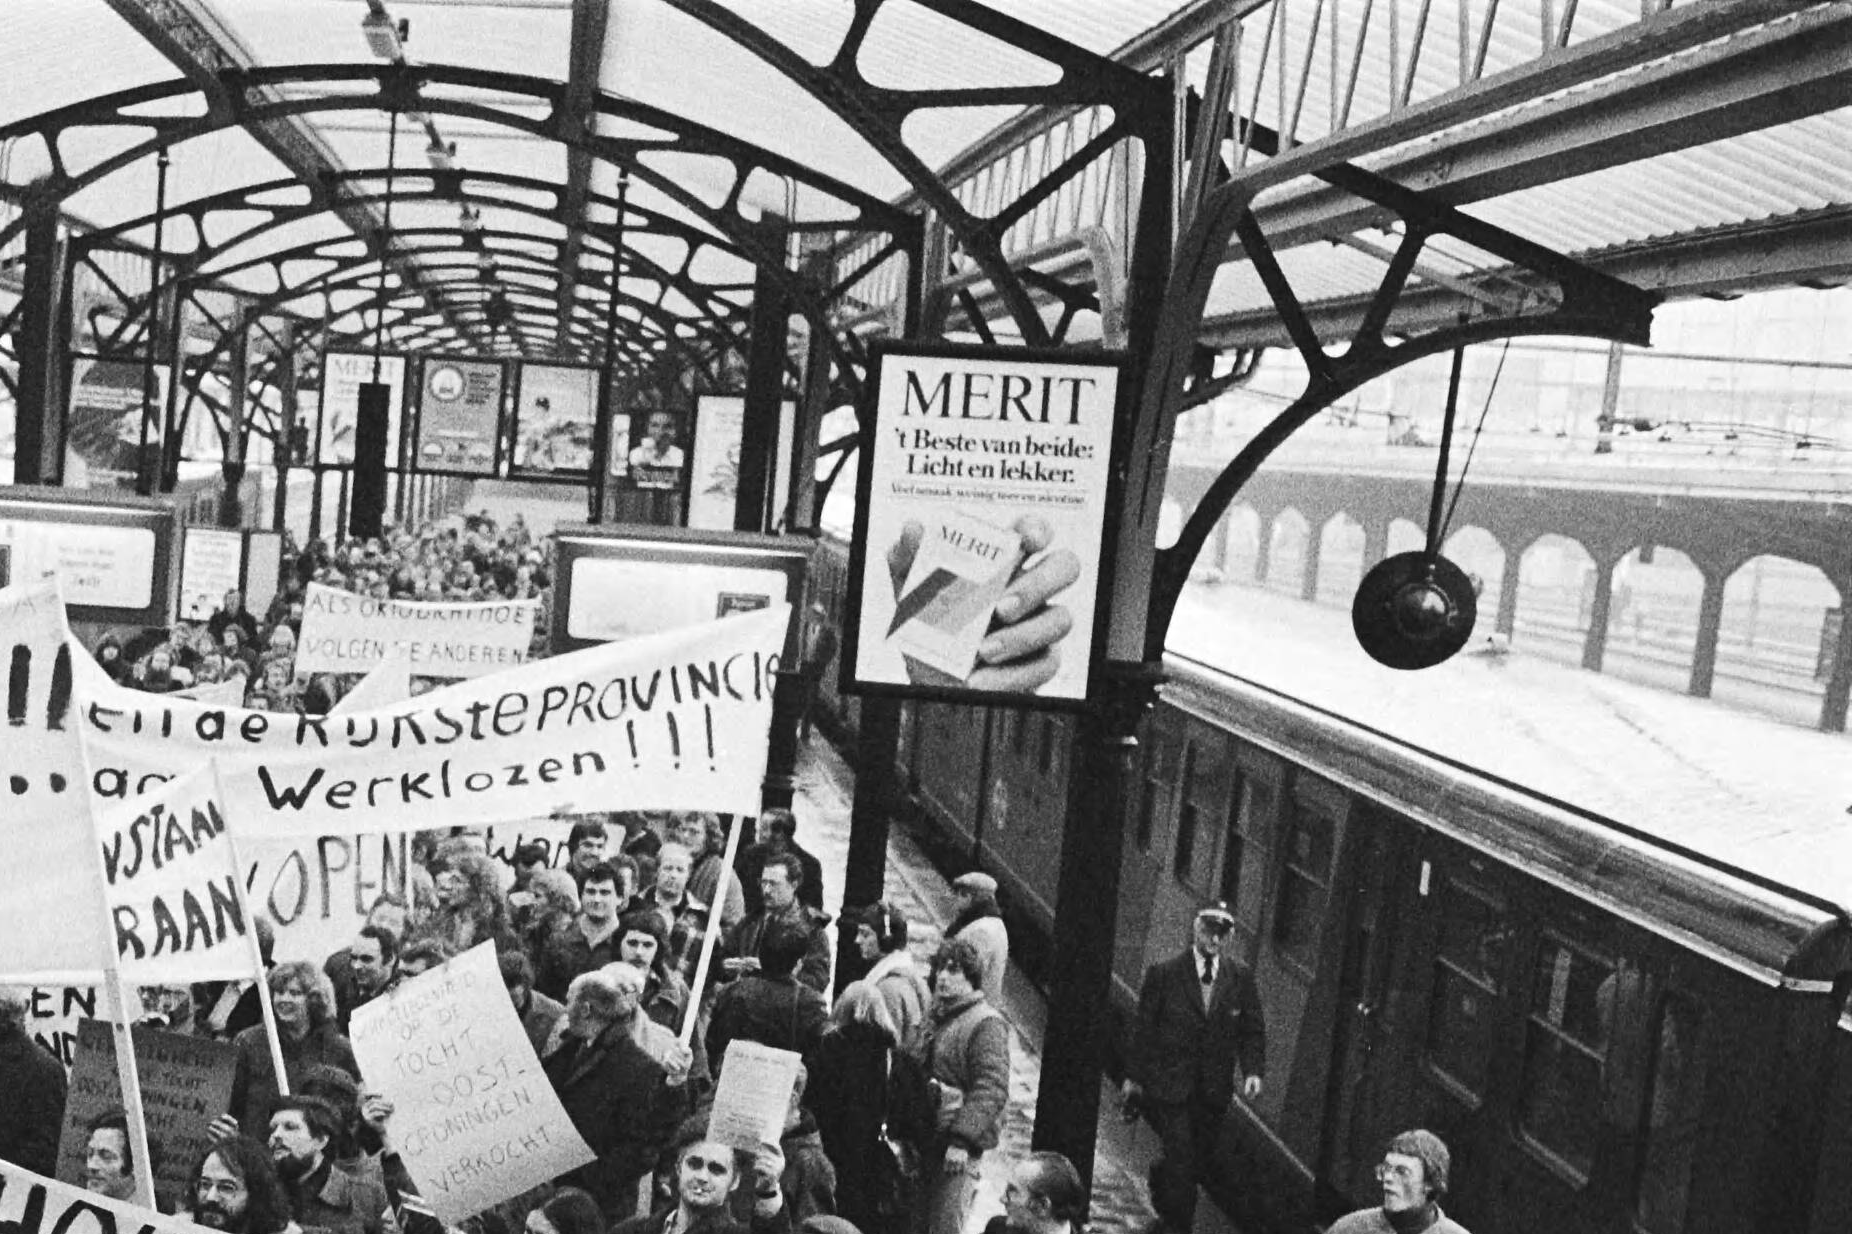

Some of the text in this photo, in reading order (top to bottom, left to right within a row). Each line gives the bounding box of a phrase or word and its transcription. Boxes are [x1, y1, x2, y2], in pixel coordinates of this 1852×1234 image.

[334, 359, 400, 381] MERT
[903, 369, 1096, 425] MERIT
[913, 428, 977, 453] Beste
[981, 438, 1021, 455] van
[1024, 432, 1094, 459] beide:
[906, 453, 1075, 483] Licht en lekker.
[941, 525, 1003, 561] MERIT
[306, 638, 385, 661] VOLGEN
[429, 641, 524, 665] ANDEREN
